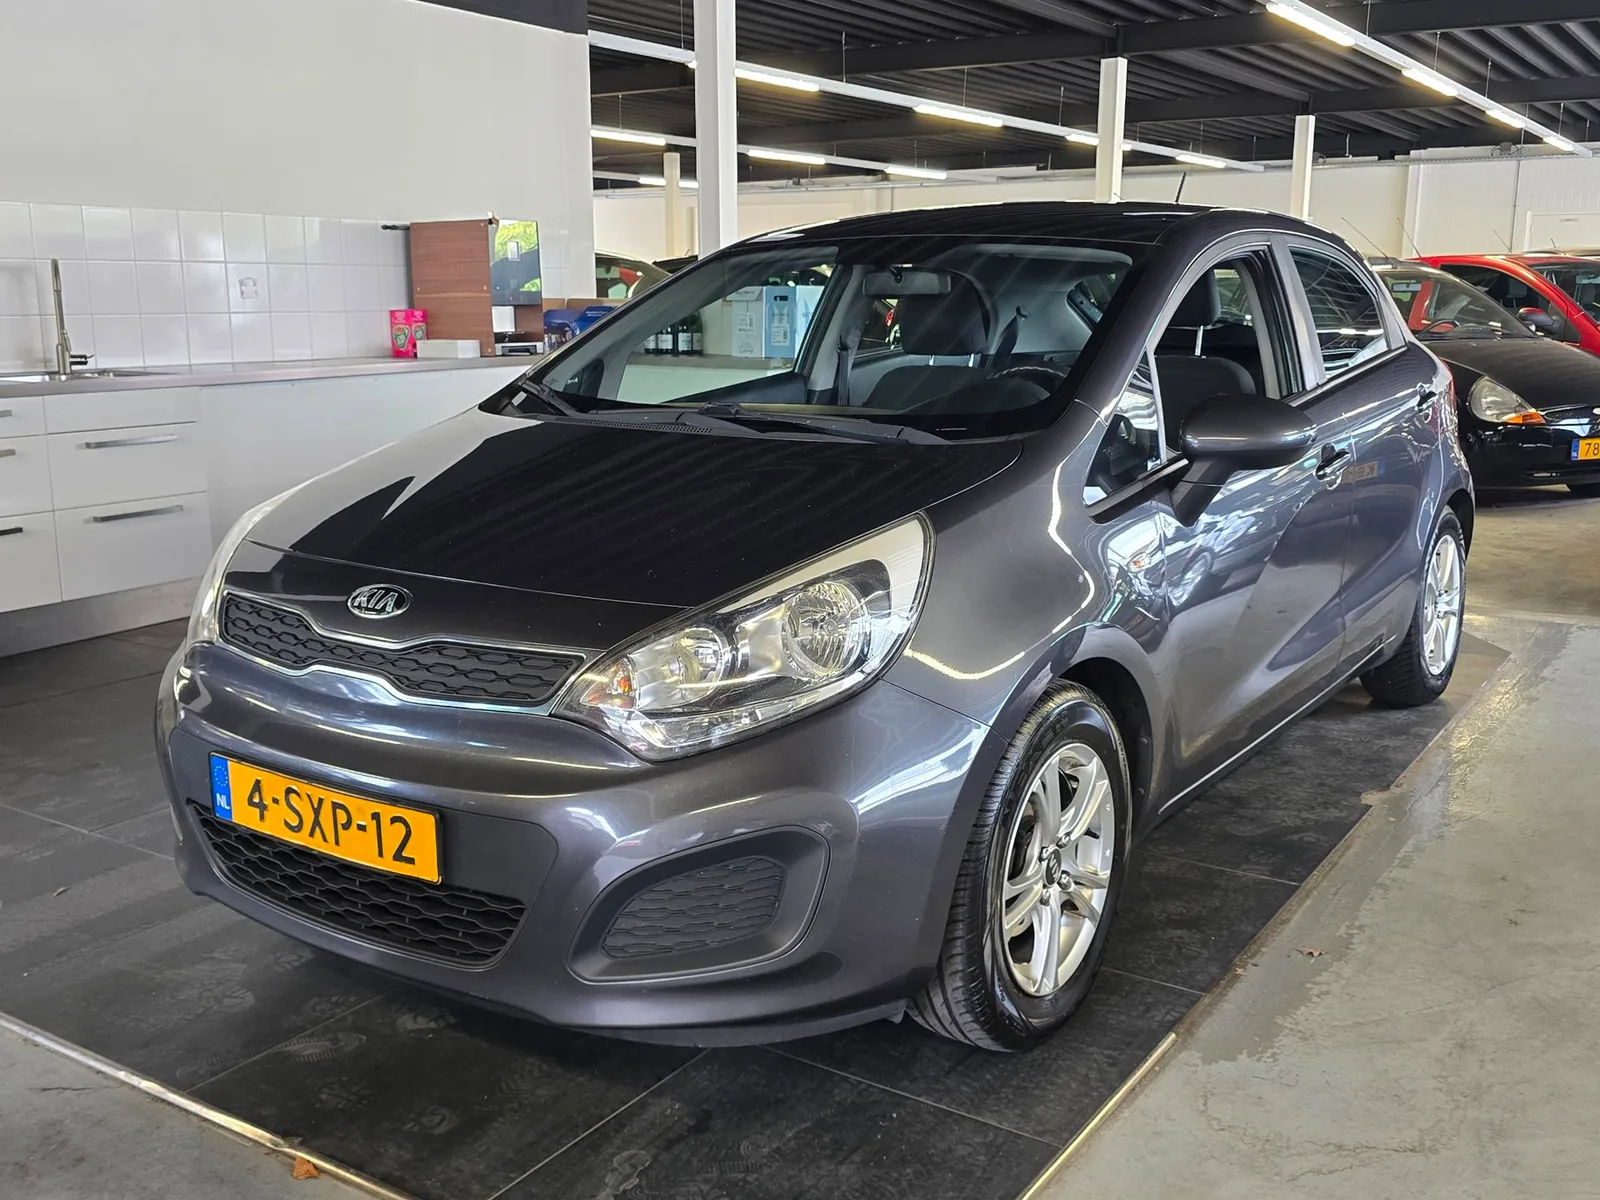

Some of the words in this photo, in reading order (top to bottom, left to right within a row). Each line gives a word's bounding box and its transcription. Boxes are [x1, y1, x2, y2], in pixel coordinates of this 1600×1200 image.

[353, 588, 399, 612] KIA
[215, 792, 231, 810] NL
[247, 778, 416, 865] 4-SXP-12
